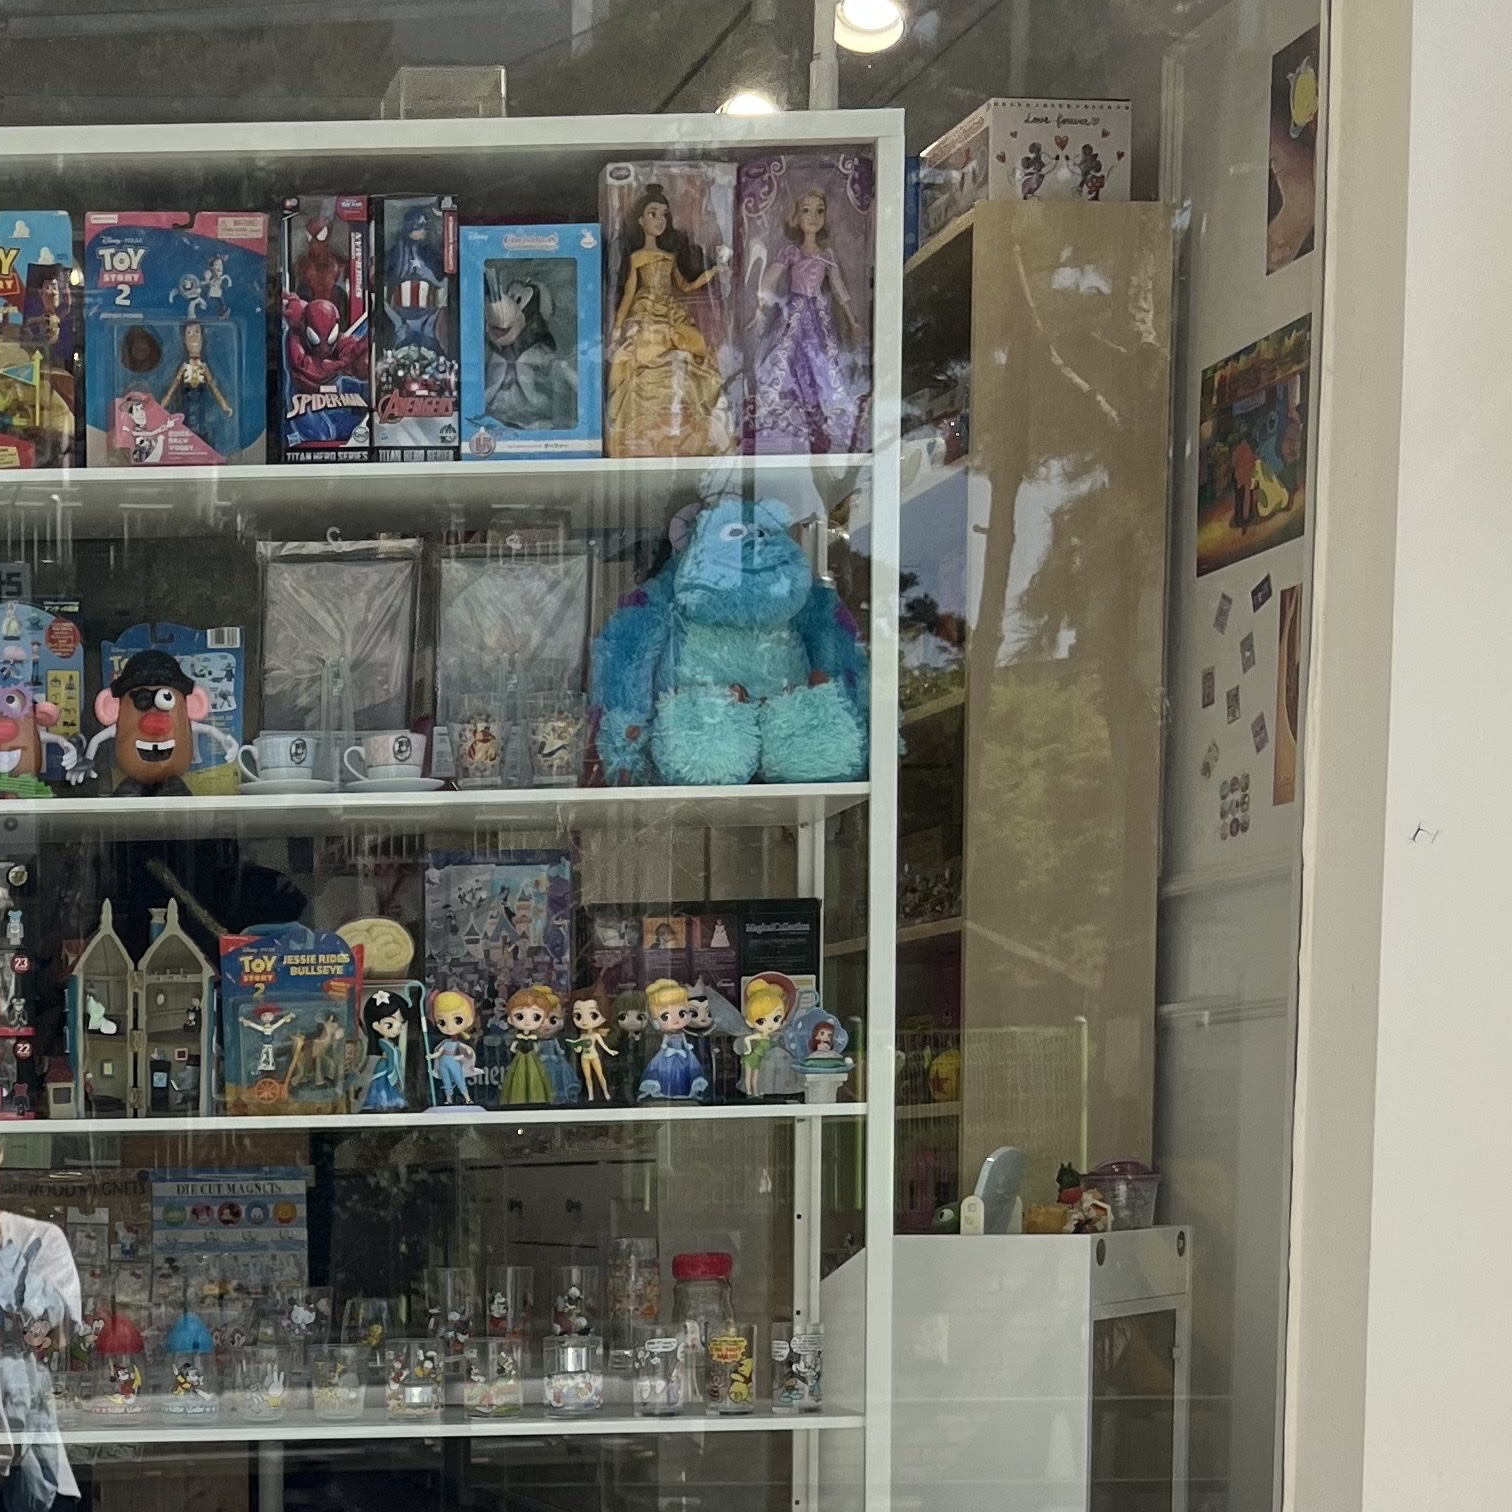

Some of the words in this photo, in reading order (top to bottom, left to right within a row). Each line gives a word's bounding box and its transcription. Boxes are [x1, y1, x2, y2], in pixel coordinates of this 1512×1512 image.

[1024, 112, 1050, 124] Love
[97, 247, 146, 272] TOY
[114, 283, 131, 307] 2
[14, 957, 29, 971] 23
[239, 955, 278, 974] TOY
[282, 954, 317, 965] JESSIE
[318, 953, 351, 965] RIDES
[289, 965, 344, 977] BULLSEYE
[16, 1042, 31, 1055] 22
[176, 1183, 197, 1196] DIE
[199, 1183, 223, 1195] CUT
[226, 1182, 283, 1195] MAGNETS
